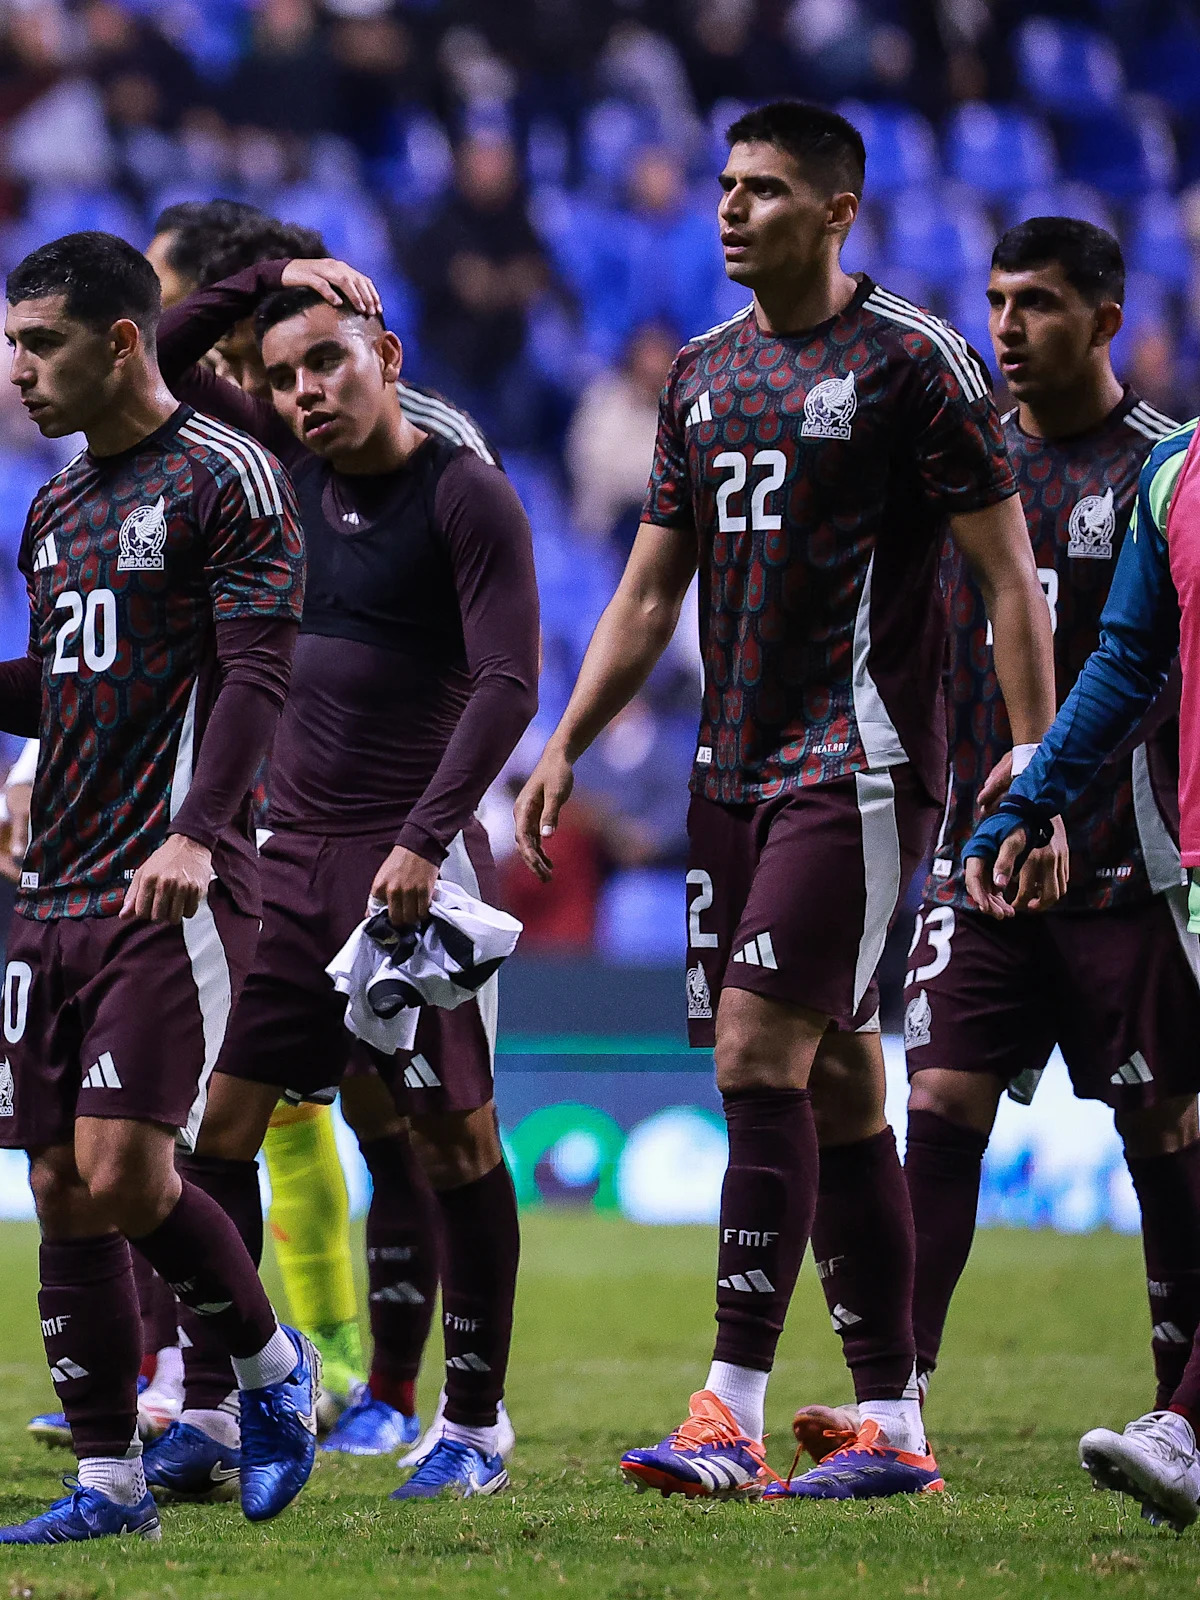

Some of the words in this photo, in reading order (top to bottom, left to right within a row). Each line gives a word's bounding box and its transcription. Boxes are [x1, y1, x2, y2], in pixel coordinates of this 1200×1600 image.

[803, 424, 849, 437] MÉXICO
[712, 449, 787, 533] 22
[119, 555, 161, 568] MÉXICO
[52, 588, 117, 674] 20
[723, 1228, 779, 1246] FMF
[40, 1314, 71, 1337] MF
